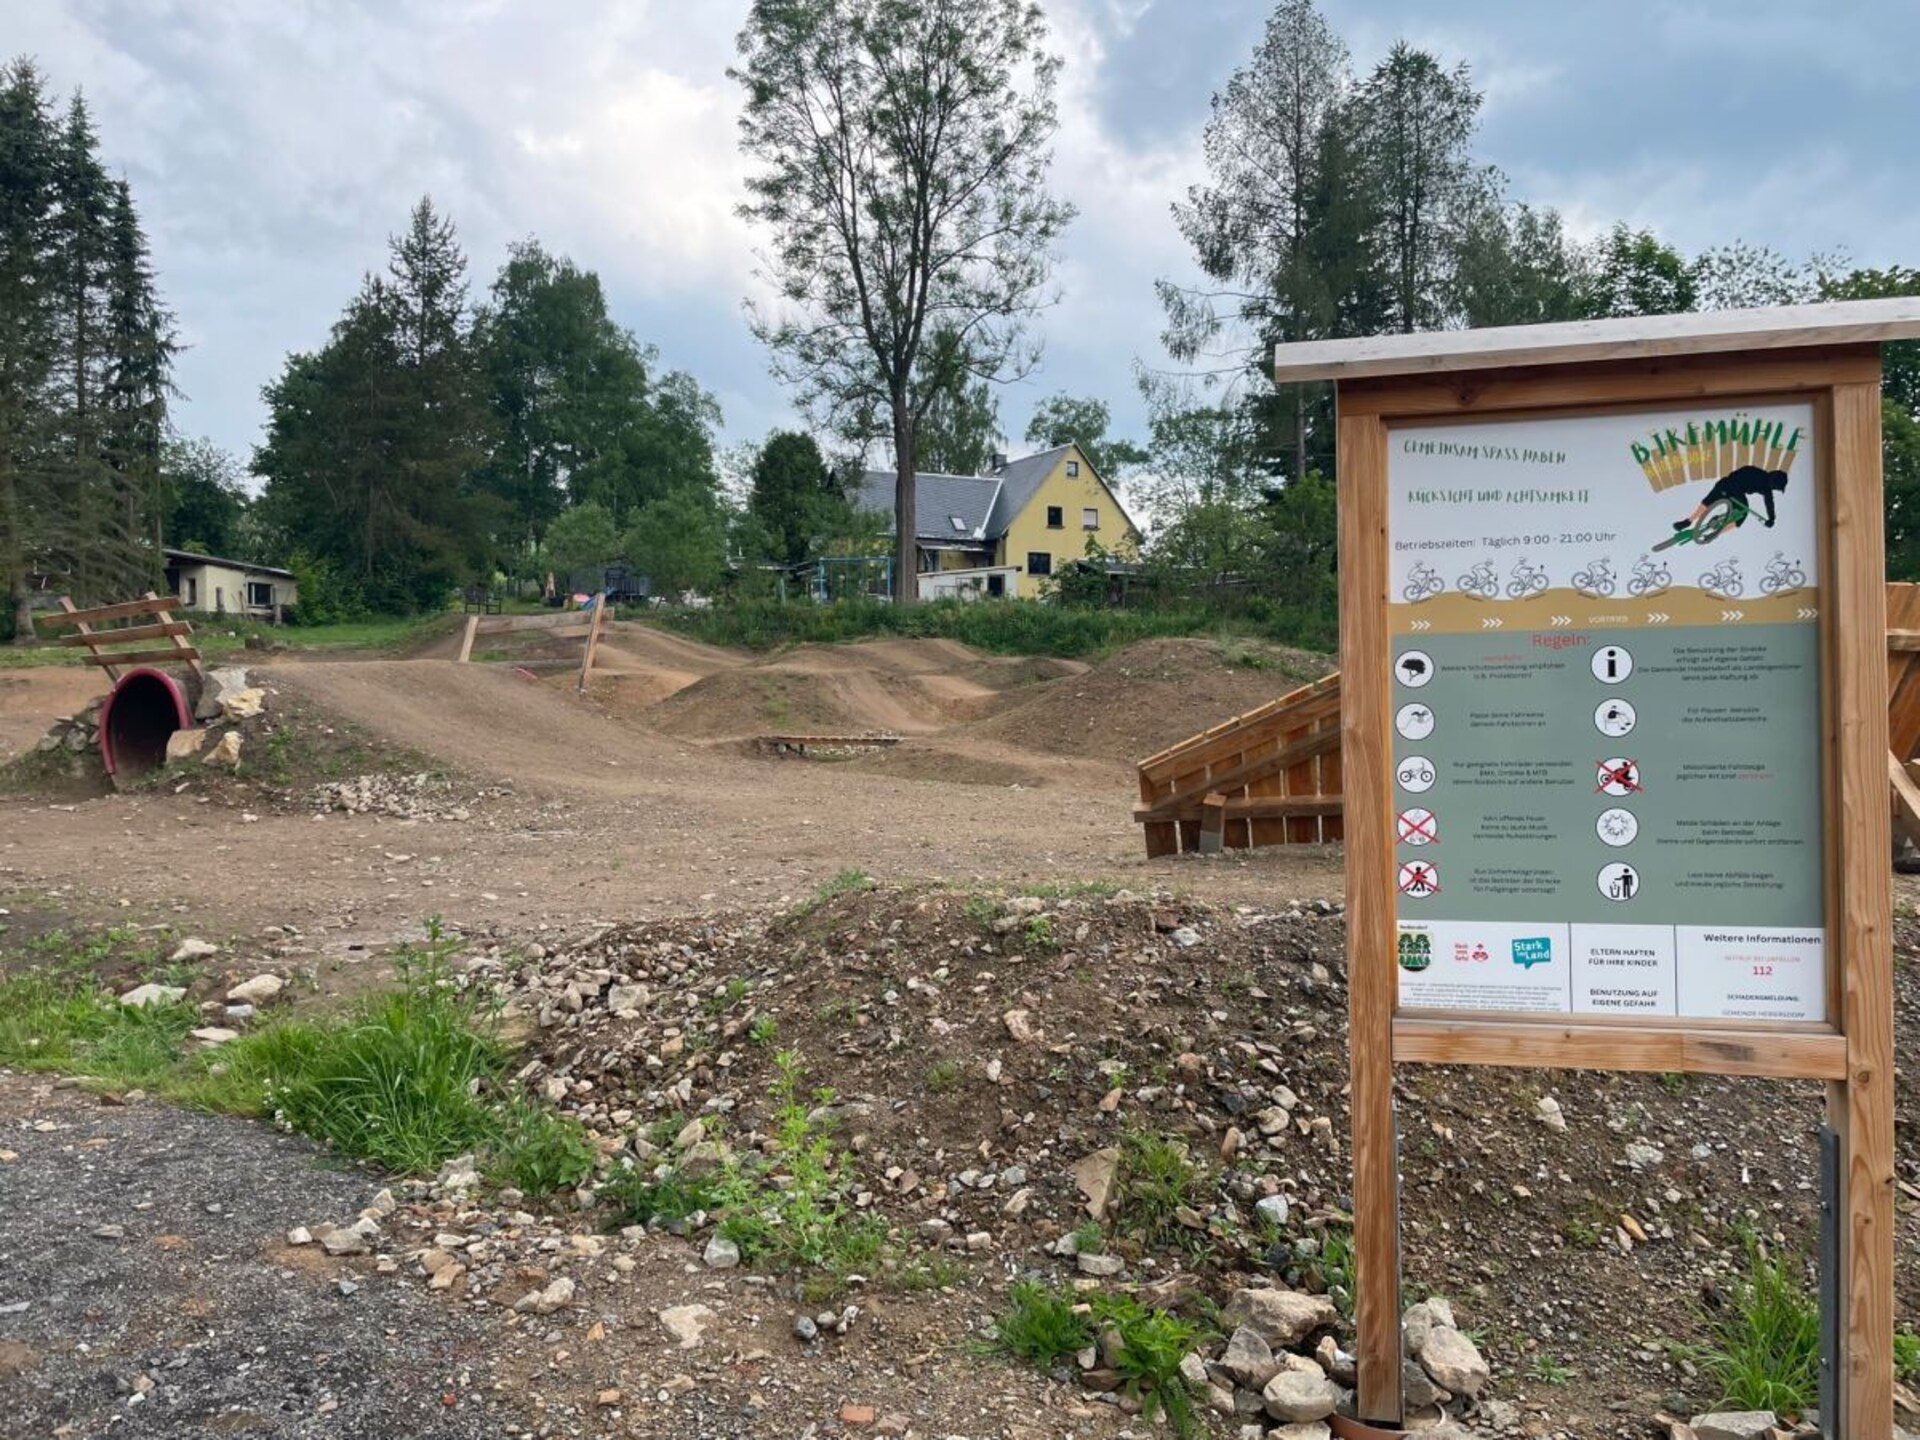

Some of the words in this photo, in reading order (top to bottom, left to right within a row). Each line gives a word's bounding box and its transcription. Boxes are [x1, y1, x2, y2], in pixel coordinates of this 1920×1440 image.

[1631, 412, 1805, 465] BIKEMÜHLE
[1404, 439, 1478, 459] GEMEINSAM
[1482, 445, 1519, 461] SPASS
[1523, 449, 1566, 464] HABEN
[1482, 536, 1520, 549] Täglich
[1560, 532, 1592, 544] 21:00
[1595, 531, 1616, 543] Uhr
[1532, 633, 1591, 650] Regeln:
[1703, 933, 1744, 944] Weitere
[1746, 934, 1822, 945] Informationen
[1513, 940, 1543, 951] Stark
[1526, 949, 1550, 960] Land
[1590, 948, 1622, 957] ELTERN
[1623, 948, 1656, 957] HAFTEN
[1588, 957, 1605, 966] FÜR
[1606, 958, 1625, 967] IHRE
[1626, 959, 1658, 967] KINDER
[1752, 965, 1773, 976] 112
[1590, 988, 1640, 998] BENUTZUNG
[1641, 990, 1658, 998] AUF
[1592, 999, 1622, 1007] EIGENE
[1622, 999, 1657, 1008] GEFAHR
